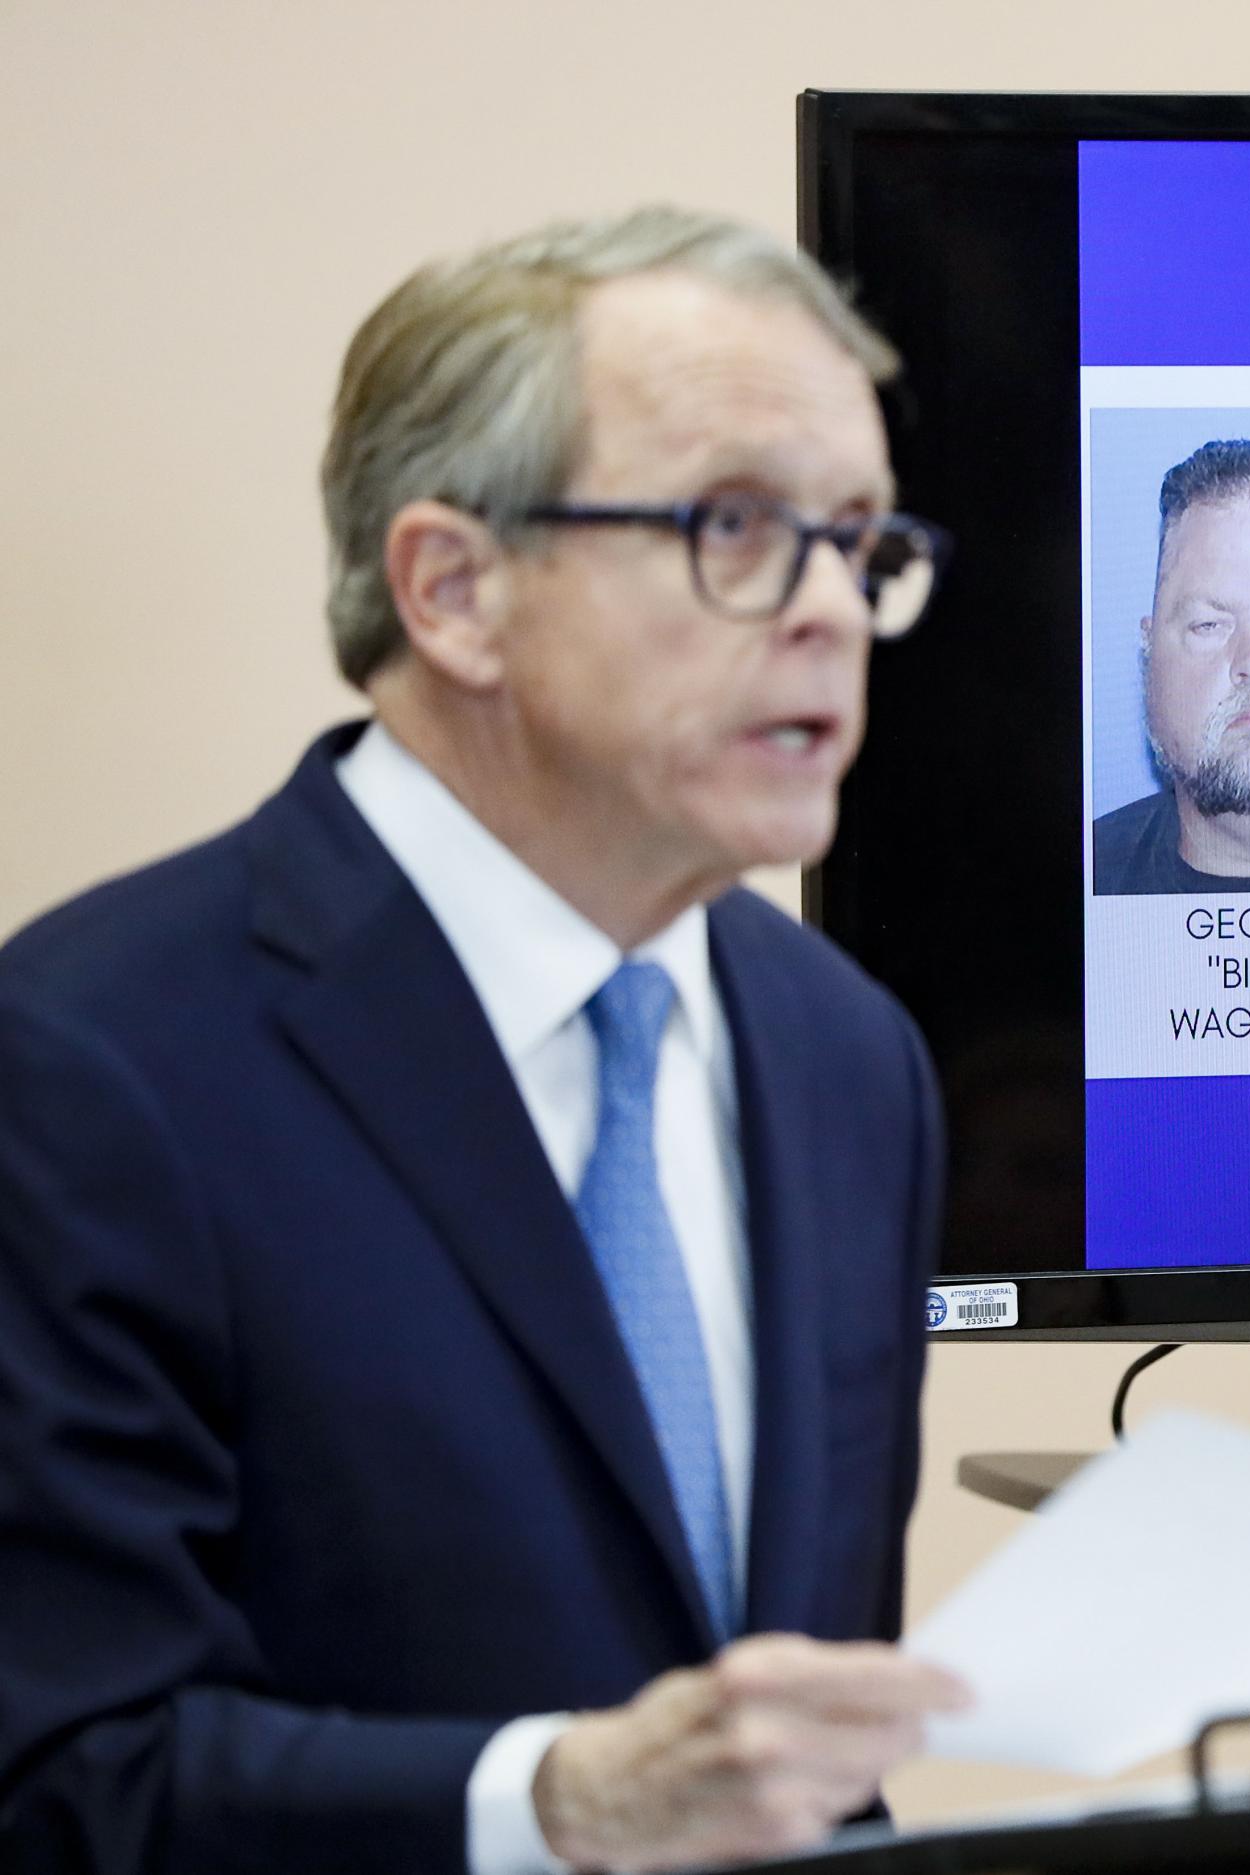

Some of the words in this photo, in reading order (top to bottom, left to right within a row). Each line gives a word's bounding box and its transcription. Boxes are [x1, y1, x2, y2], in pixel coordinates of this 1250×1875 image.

[950, 1290, 981, 1298] ATTORNEY
[983, 1288, 1012, 1296] GENERAL
[965, 1317, 999, 1325] 233534
